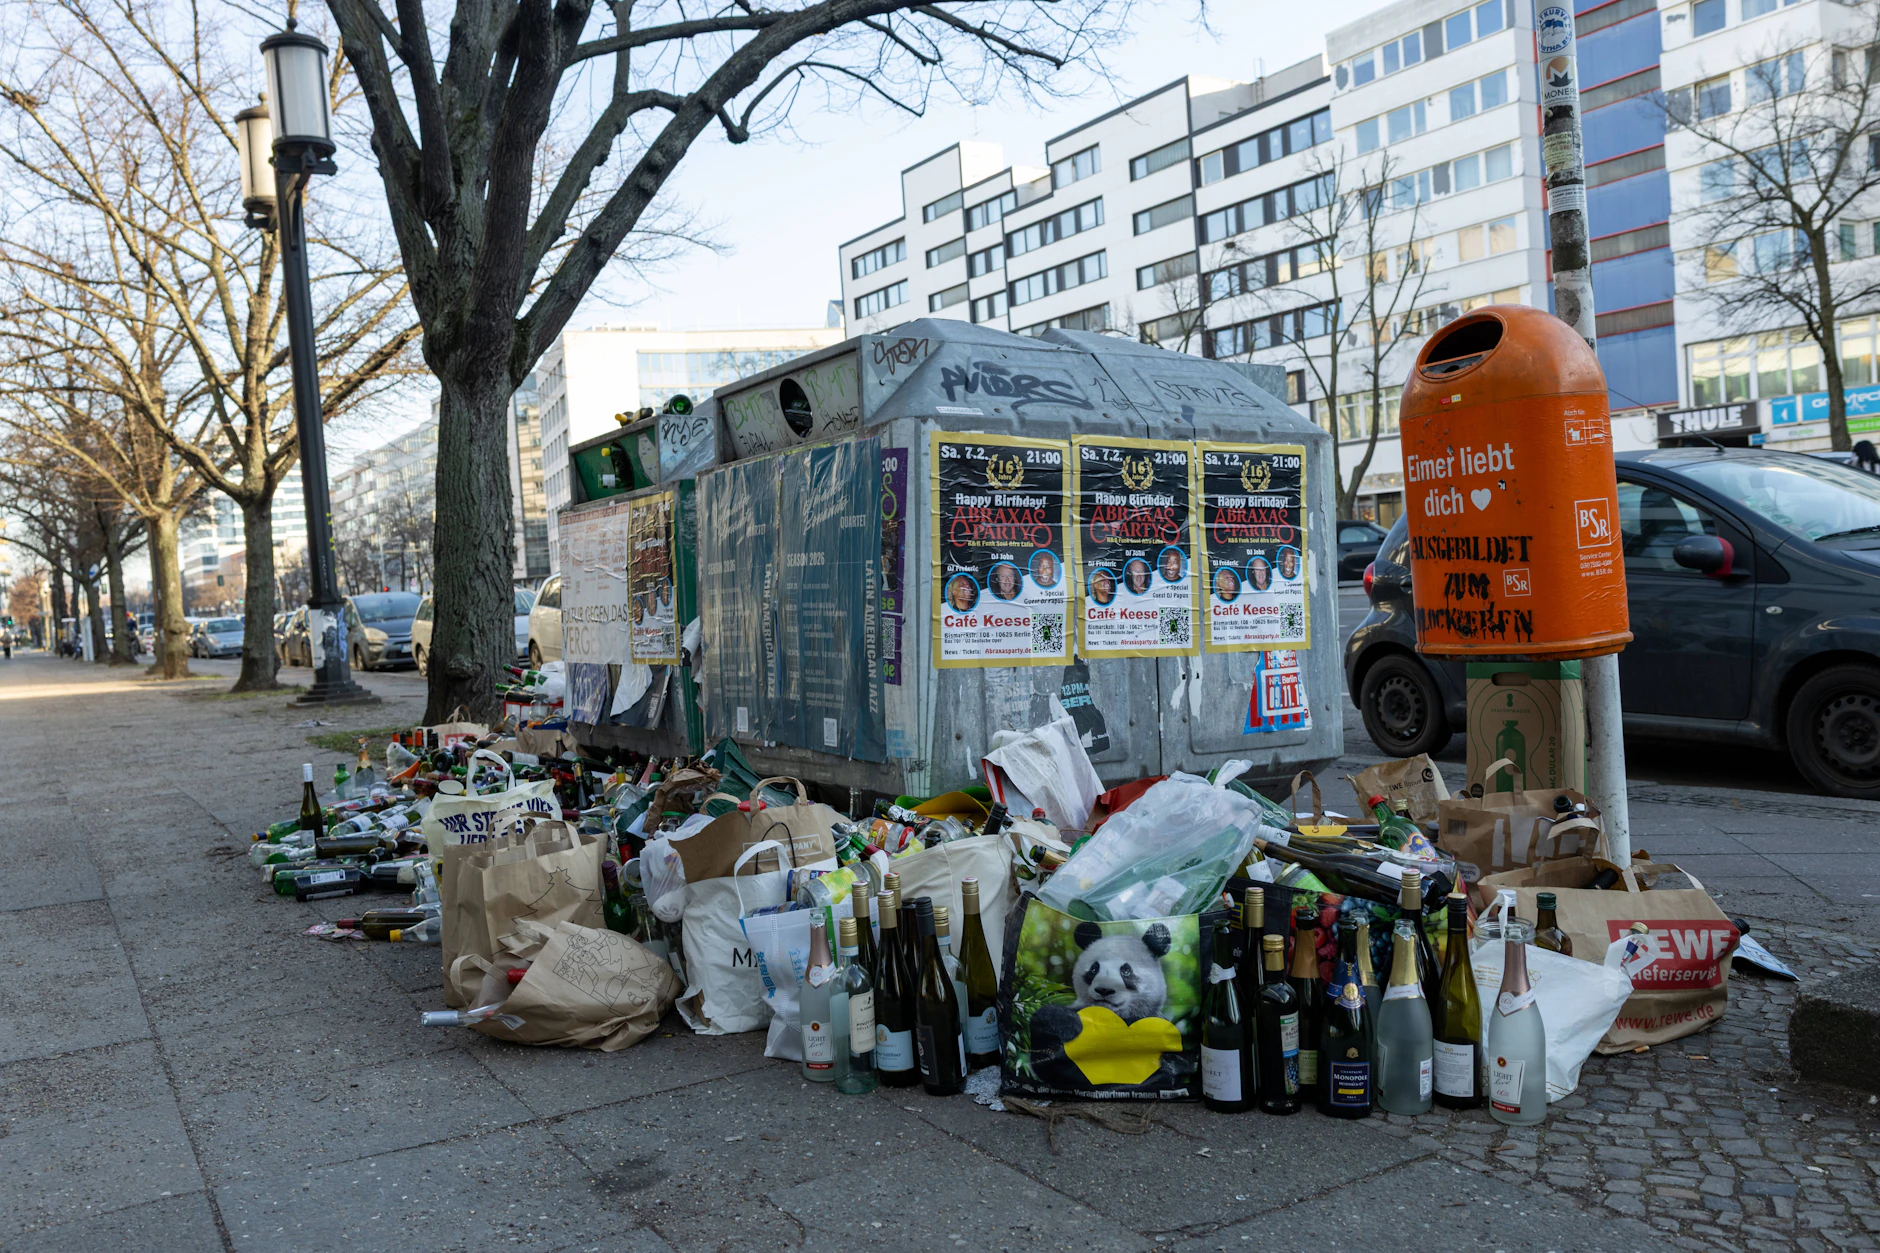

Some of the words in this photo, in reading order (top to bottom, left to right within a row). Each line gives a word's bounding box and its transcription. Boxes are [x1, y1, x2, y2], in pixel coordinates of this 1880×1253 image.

[1669, 406, 1743, 434] THULE
[941, 445, 960, 459] Sa.
[964, 446, 989, 460] 7.2.
[1026, 450, 1061, 464] 21:00
[1081, 447, 1099, 460] Sa.
[1102, 448, 1123, 462] 7.2.
[1154, 452, 1187, 465] 21:00
[1204, 453, 1221, 466] Sa.
[1223, 454, 1243, 466] 7.2.
[1272, 456, 1300, 468] 21:00
[1407, 454, 1455, 482] Eimer
[1460, 442, 1515, 476] liebt
[998, 460, 1014, 475] 16
[1131, 461, 1145, 475] 16
[1250, 465, 1263, 477] 16
[955, 493, 991, 508] Happy
[994, 494, 1047, 509] Birthday!
[1095, 493, 1127, 507] Happy
[1129, 493, 1175, 508] Birthday!
[1218, 496, 1246, 508] Happy
[1248, 496, 1289, 509] Birthday!
[1424, 486, 1464, 517] dich
[840, 514, 867, 529] QUARTET
[950, 506, 1051, 536] ABRAXAS
[1090, 506, 1180, 535] ABRAXAS
[1213, 508, 1294, 535] ABRAXAS
[1580, 508, 1609, 538] BSR
[973, 523, 1031, 540] PARTY
[1109, 522, 1162, 538] PARTY
[1231, 524, 1277, 537] PARTY
[787, 553, 808, 567] SEASON
[809, 552, 825, 566] 2026
[865, 560, 875, 600] LATIN
[1506, 574, 1528, 591] BSR
[585, 606, 609, 624] GEGEN
[611, 602, 628, 623] DAS
[1087, 608, 1116, 620] Café
[1120, 608, 1158, 619] Keese
[1213, 604, 1239, 616] Café
[1243, 604, 1279, 615] Keese
[944, 615, 978, 628] Café
[983, 614, 1031, 627] Keese
[763, 602, 775, 667] AMERICAN
[865, 603, 879, 678] AMERICAN
[767, 671, 775, 699] JAZZ
[1269, 677, 1281, 685] NFL
[1282, 675, 1298, 684] Berlin
[868, 682, 879, 714] JAZZ
[1549, 736, 1556, 747] 20
[1403, 779, 1422, 788] Bonus
[1619, 929, 1731, 961] EWE
[1615, 1003, 1715, 1030] www.rewe.de
[1493, 1070, 1513, 1081] LIGHT
